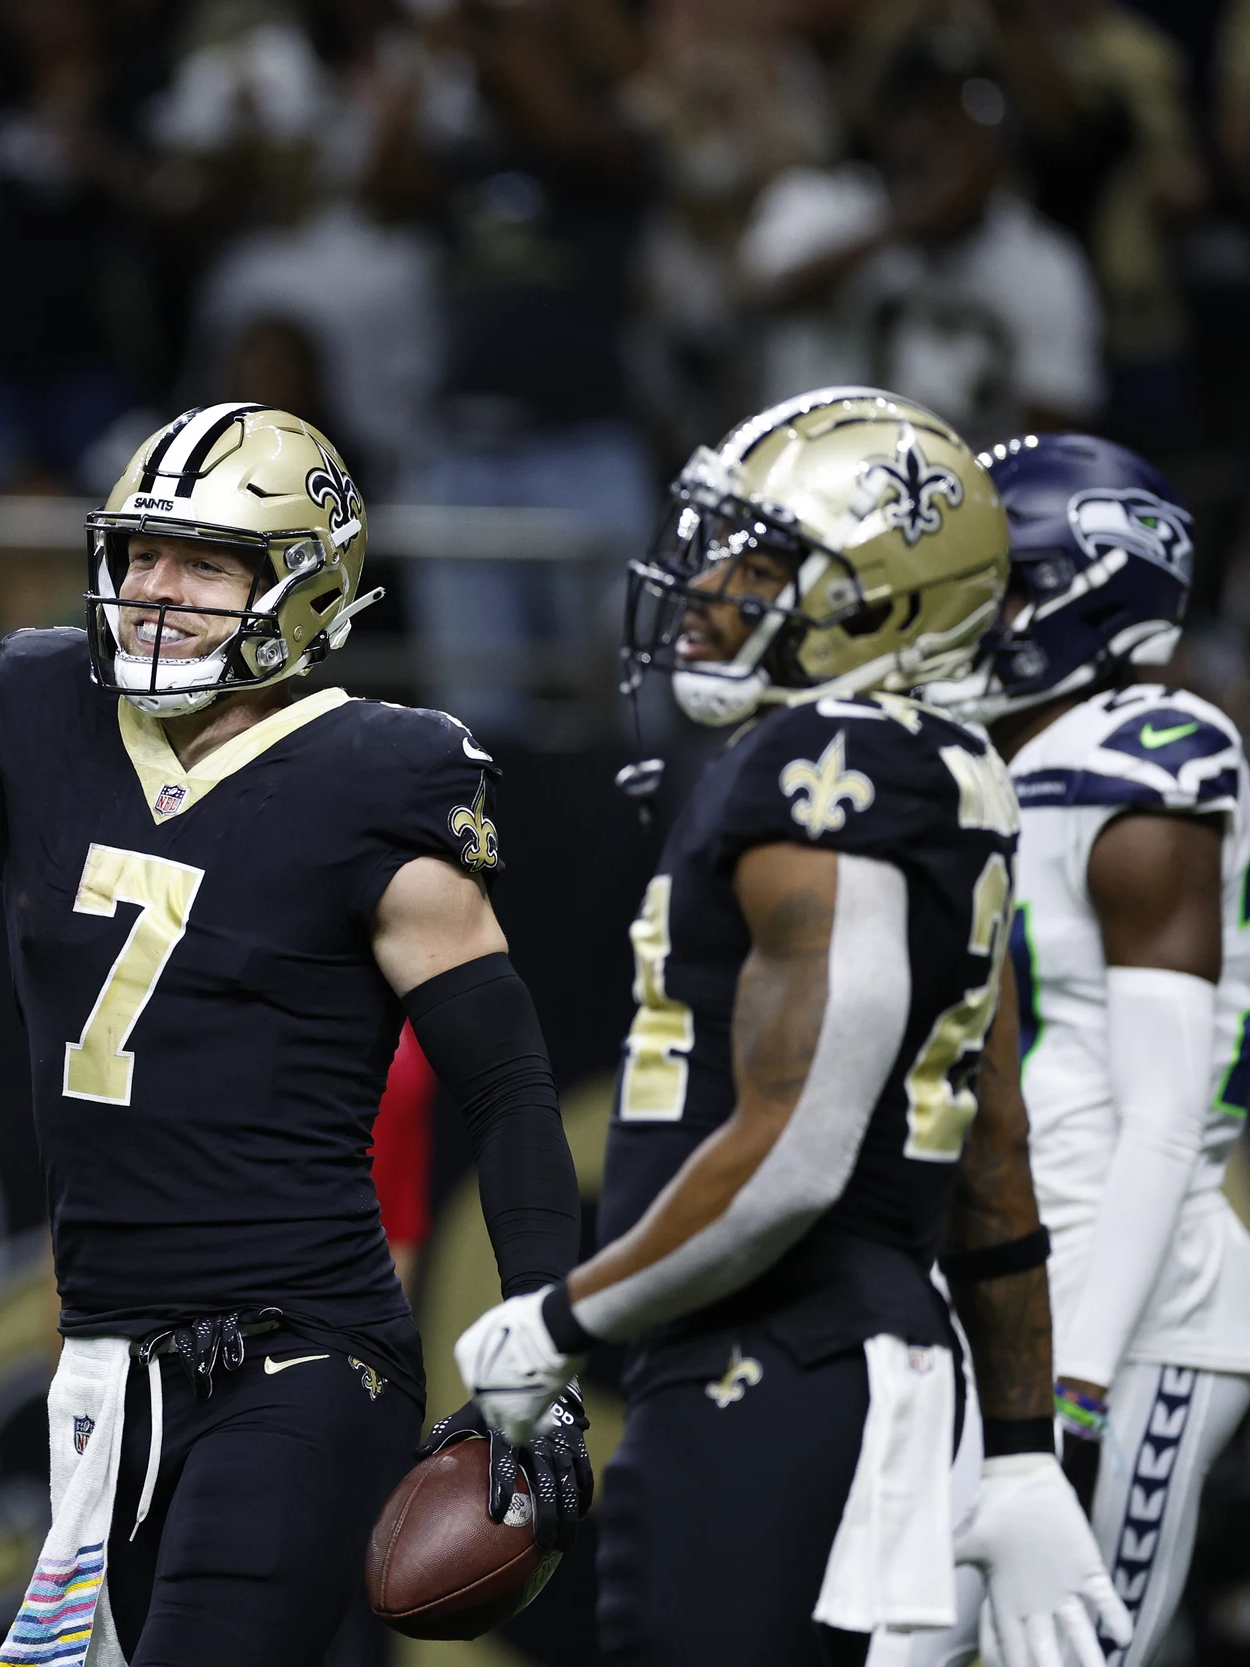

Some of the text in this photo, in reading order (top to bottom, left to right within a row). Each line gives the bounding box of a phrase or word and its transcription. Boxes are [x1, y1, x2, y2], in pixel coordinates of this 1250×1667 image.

[134, 497, 174, 511] SAINTS
[157, 795, 178, 811] NFL
[62, 843, 205, 1106] 7
